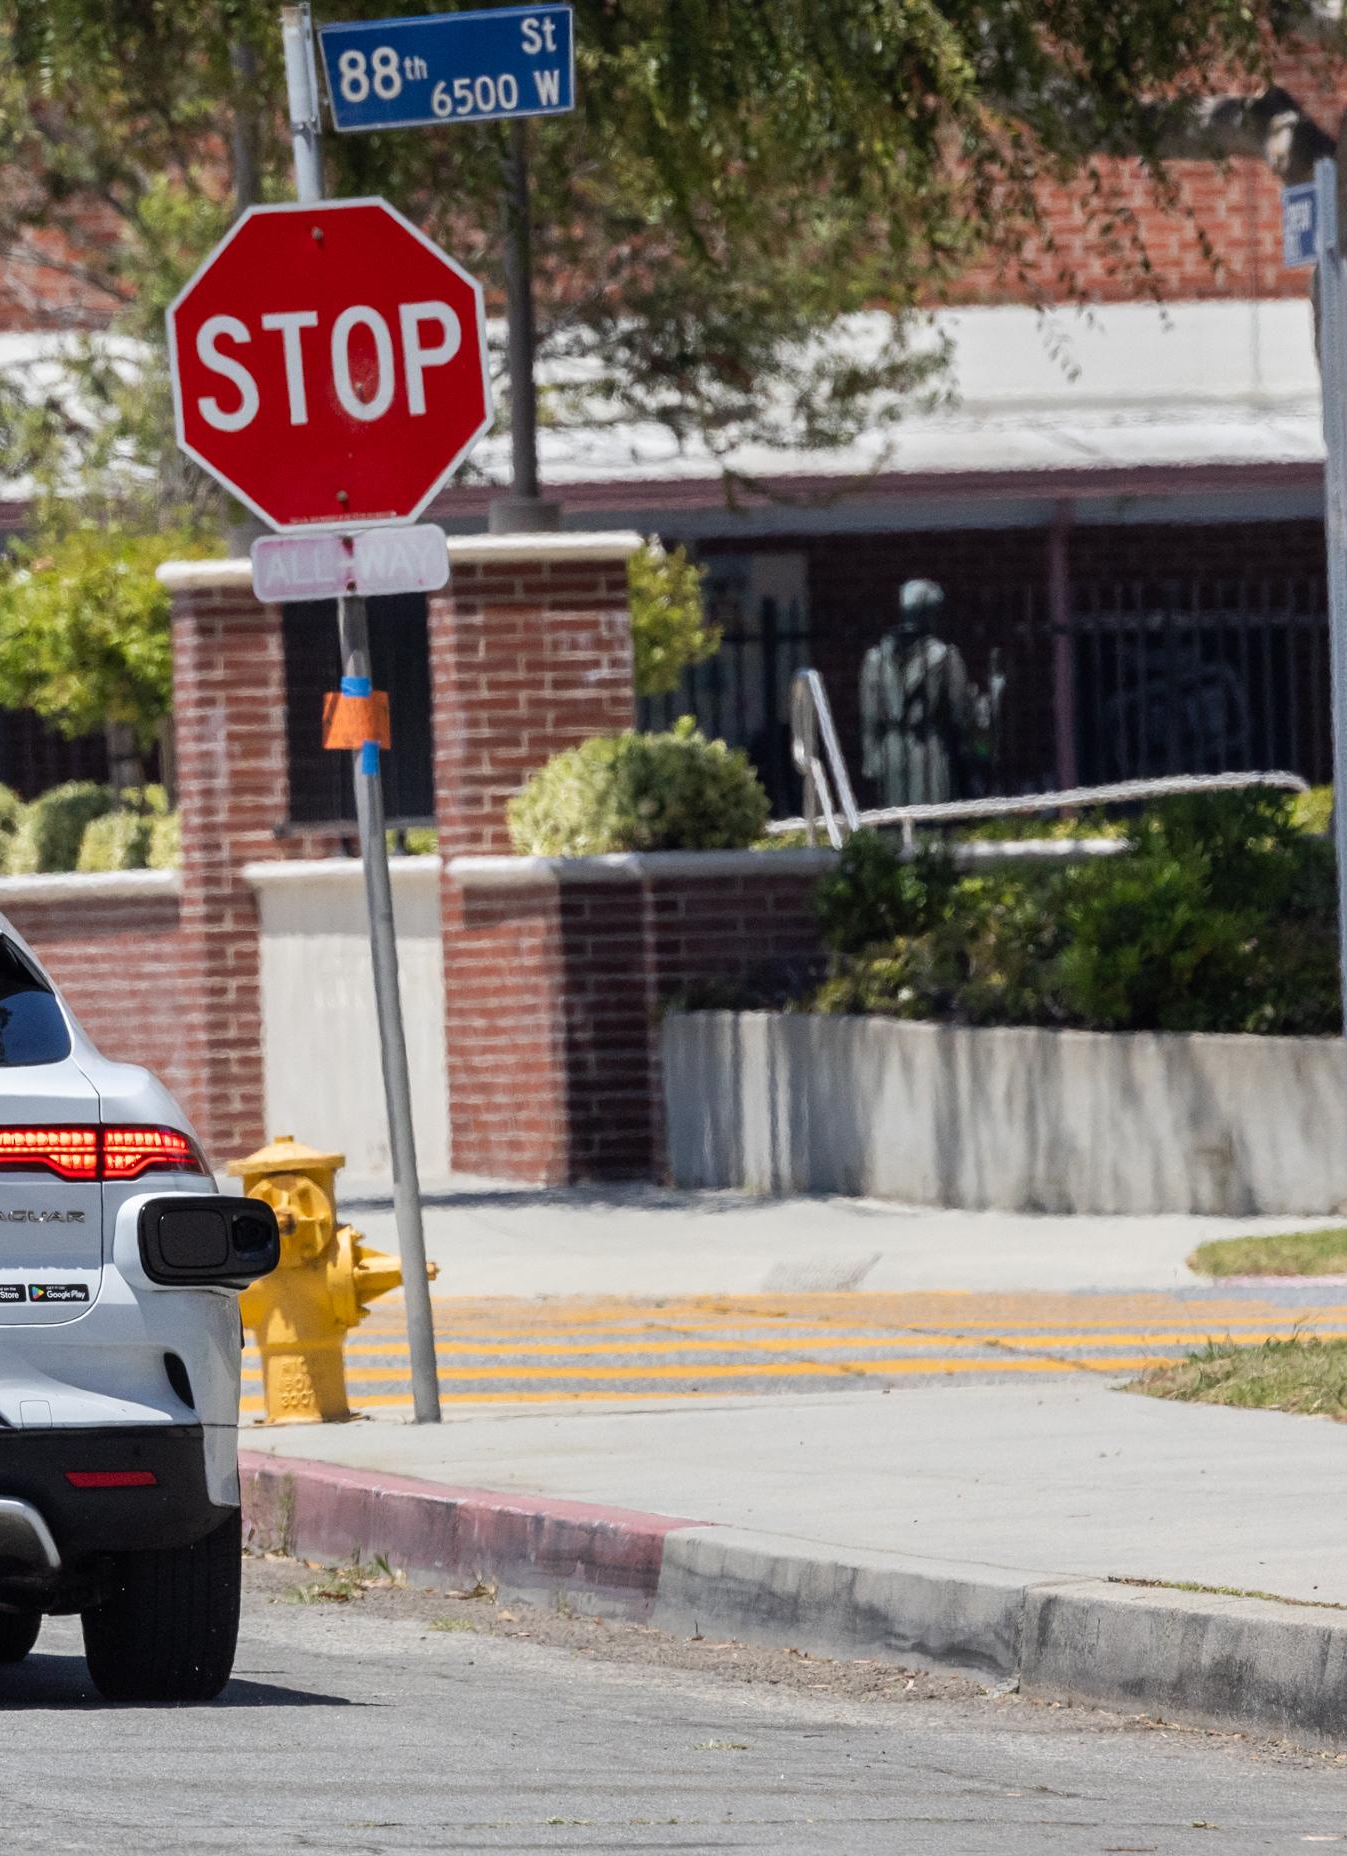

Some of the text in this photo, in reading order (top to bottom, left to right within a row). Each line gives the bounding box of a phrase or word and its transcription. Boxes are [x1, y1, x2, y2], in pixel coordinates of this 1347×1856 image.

[520, 16, 557, 55] St
[431, 69, 560, 117] 6500 W
[195, 300, 462, 432] STOP
[0, 1291, 20, 1299] Store
[46, 1290, 86, 1300] Google Play
